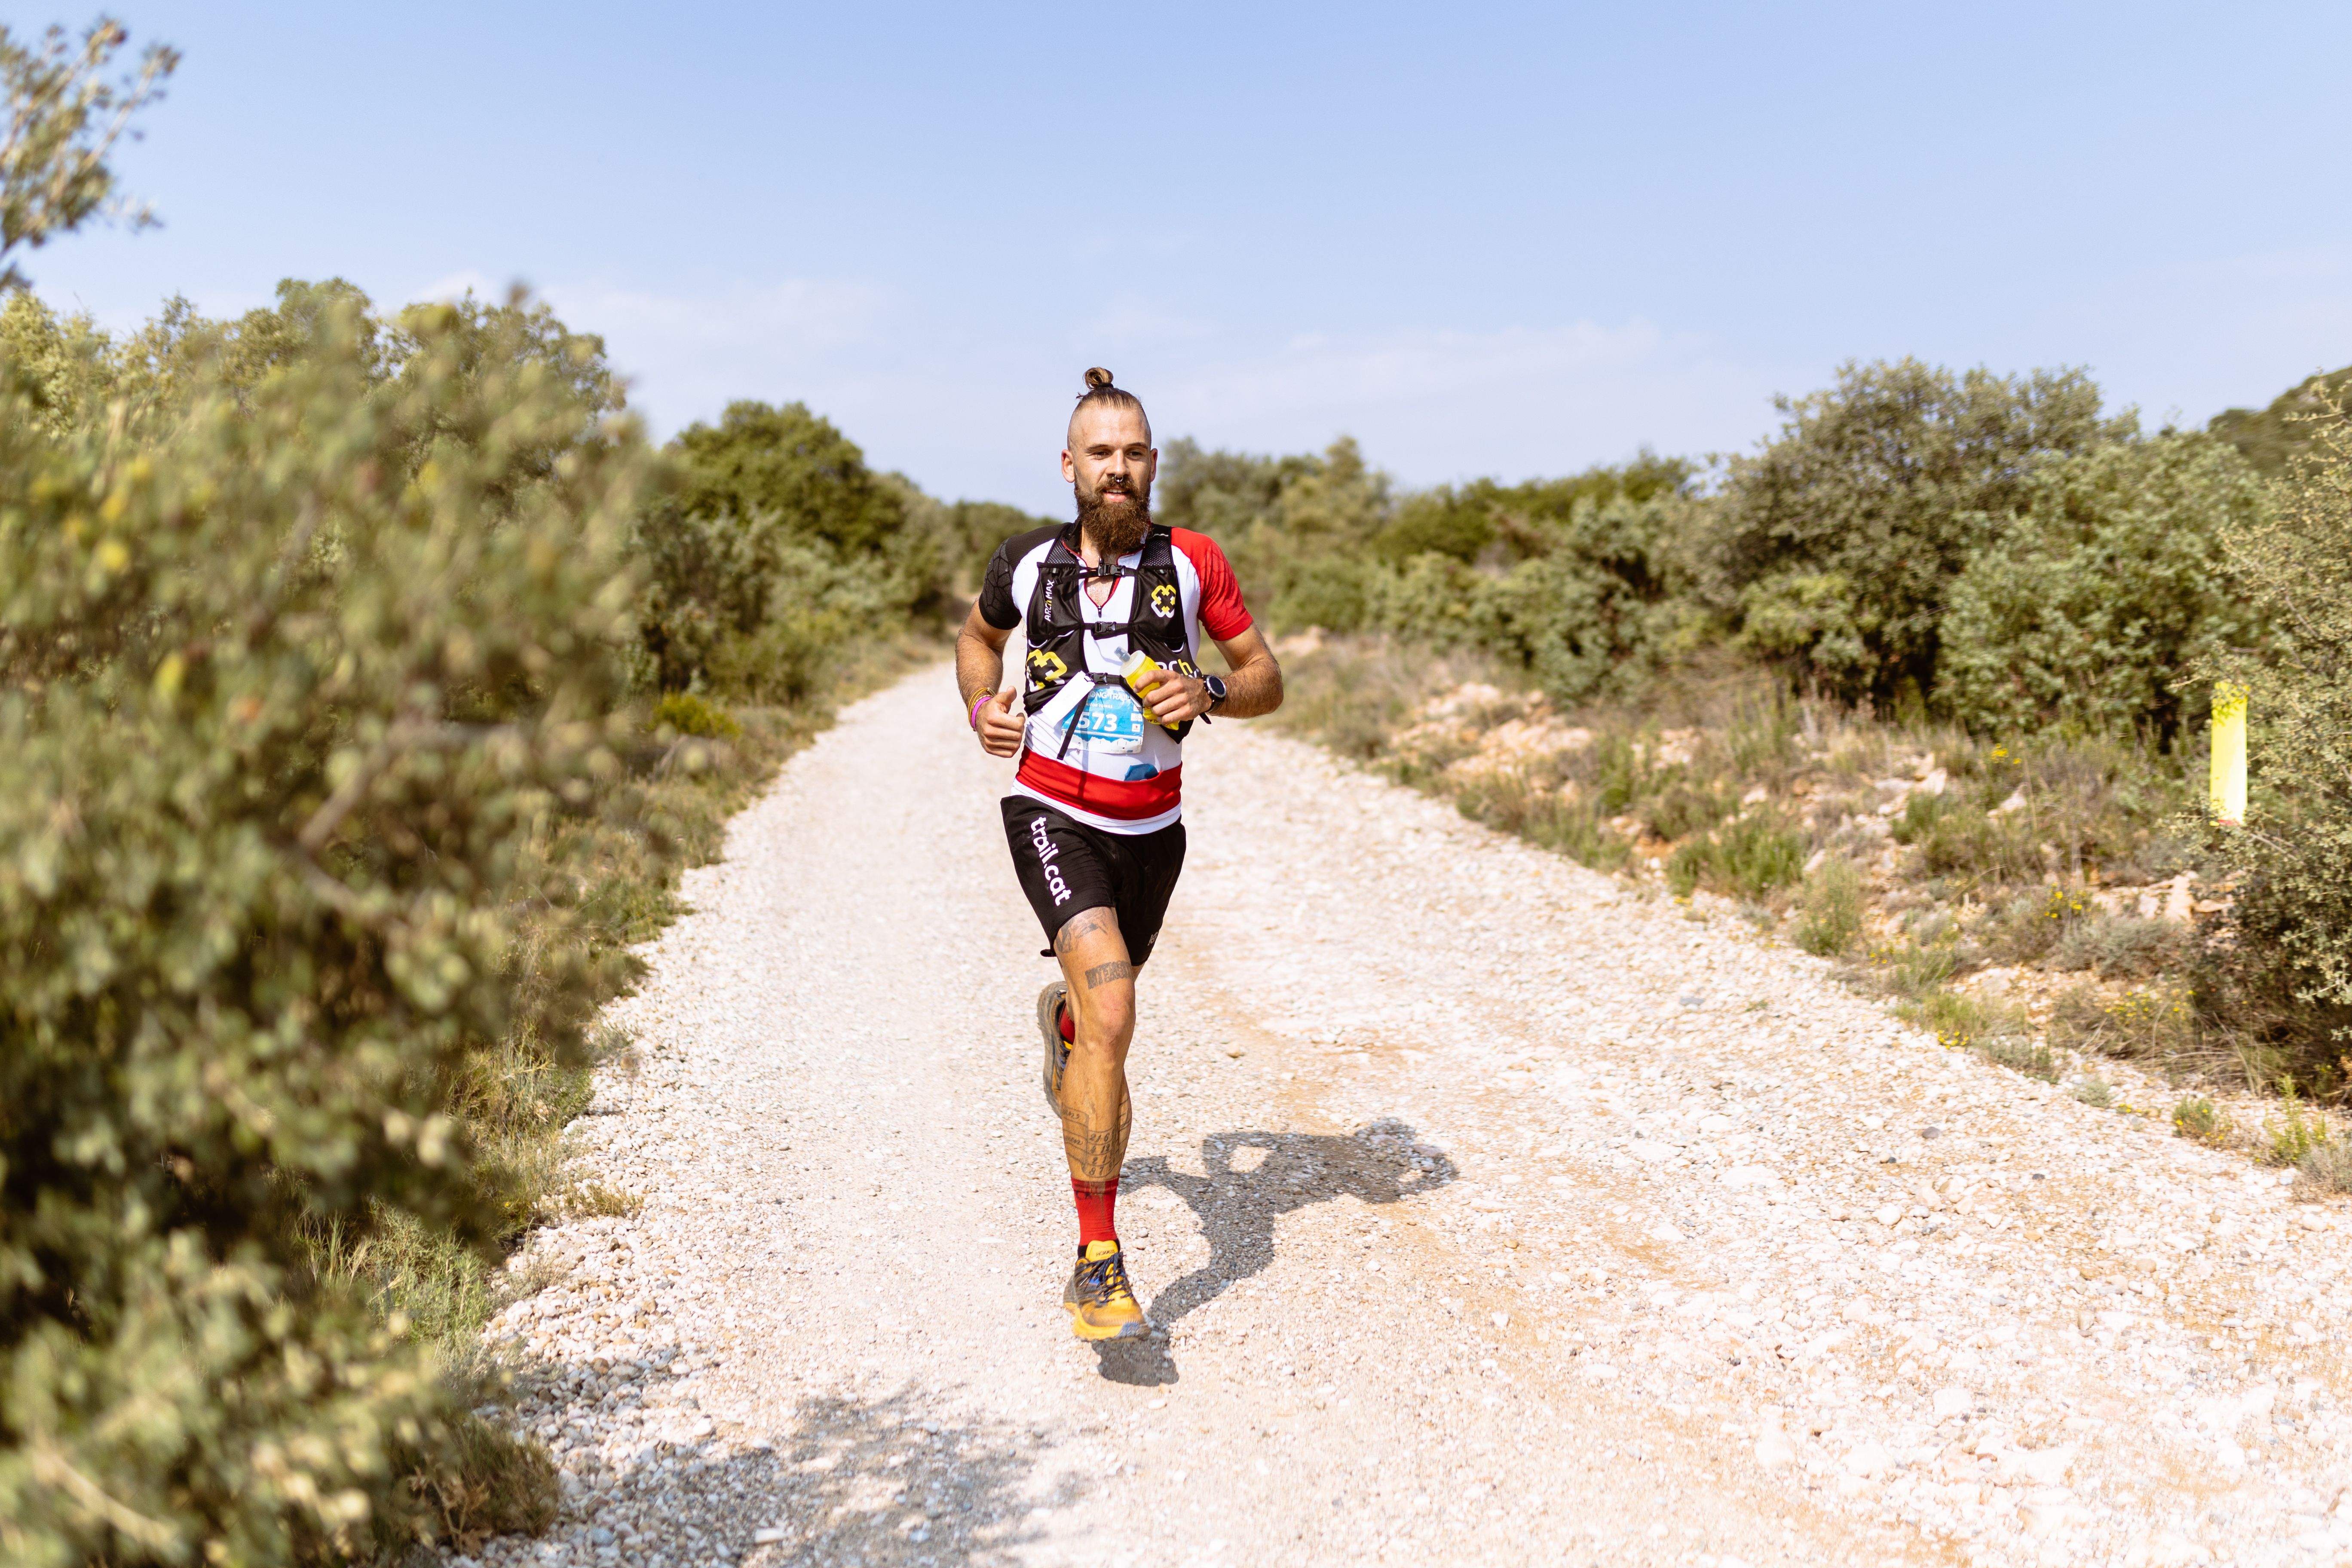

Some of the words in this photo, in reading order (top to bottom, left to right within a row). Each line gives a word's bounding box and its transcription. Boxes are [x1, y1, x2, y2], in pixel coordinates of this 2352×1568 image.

[1045, 579, 1055, 599] MAX
[1088, 691, 1108, 699] ONG
[1077, 711, 1118, 732] 573
[1031, 817, 1072, 906] trail.cat
